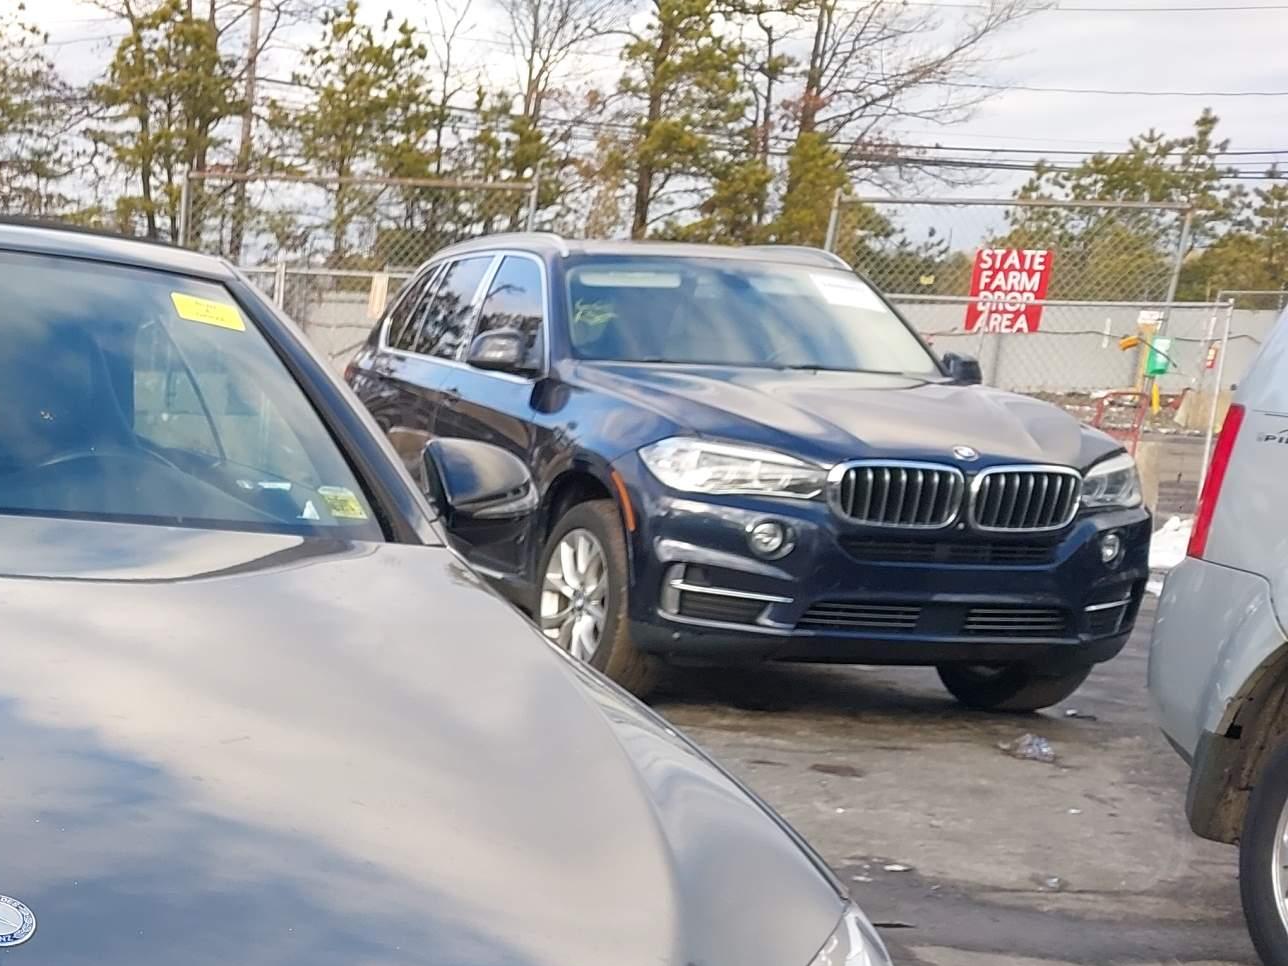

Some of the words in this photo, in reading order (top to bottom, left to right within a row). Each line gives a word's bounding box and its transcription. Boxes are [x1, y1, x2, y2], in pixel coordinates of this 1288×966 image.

[979, 249, 1047, 270] STATE
[979, 271, 1041, 291] FARM
[977, 291, 1035, 312] DROP
[972, 312, 1029, 333] AREA
